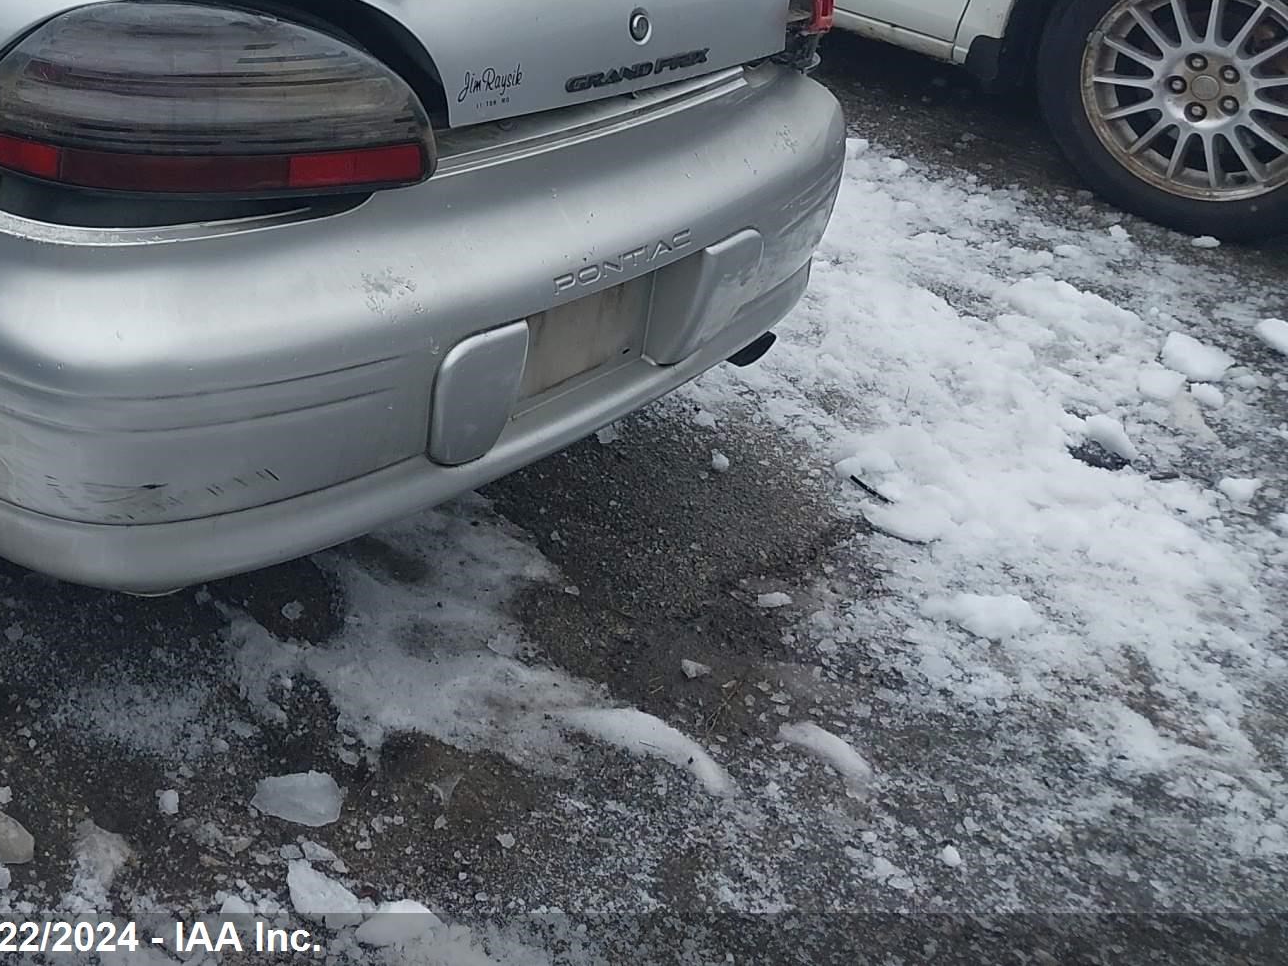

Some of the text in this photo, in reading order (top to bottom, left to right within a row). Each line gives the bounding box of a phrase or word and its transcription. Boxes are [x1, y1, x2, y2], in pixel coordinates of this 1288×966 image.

[457, 63, 523, 103] Jim Raysik
[565, 48, 710, 93] GRAND PRIX
[553, 227, 692, 296] PONTIAC
